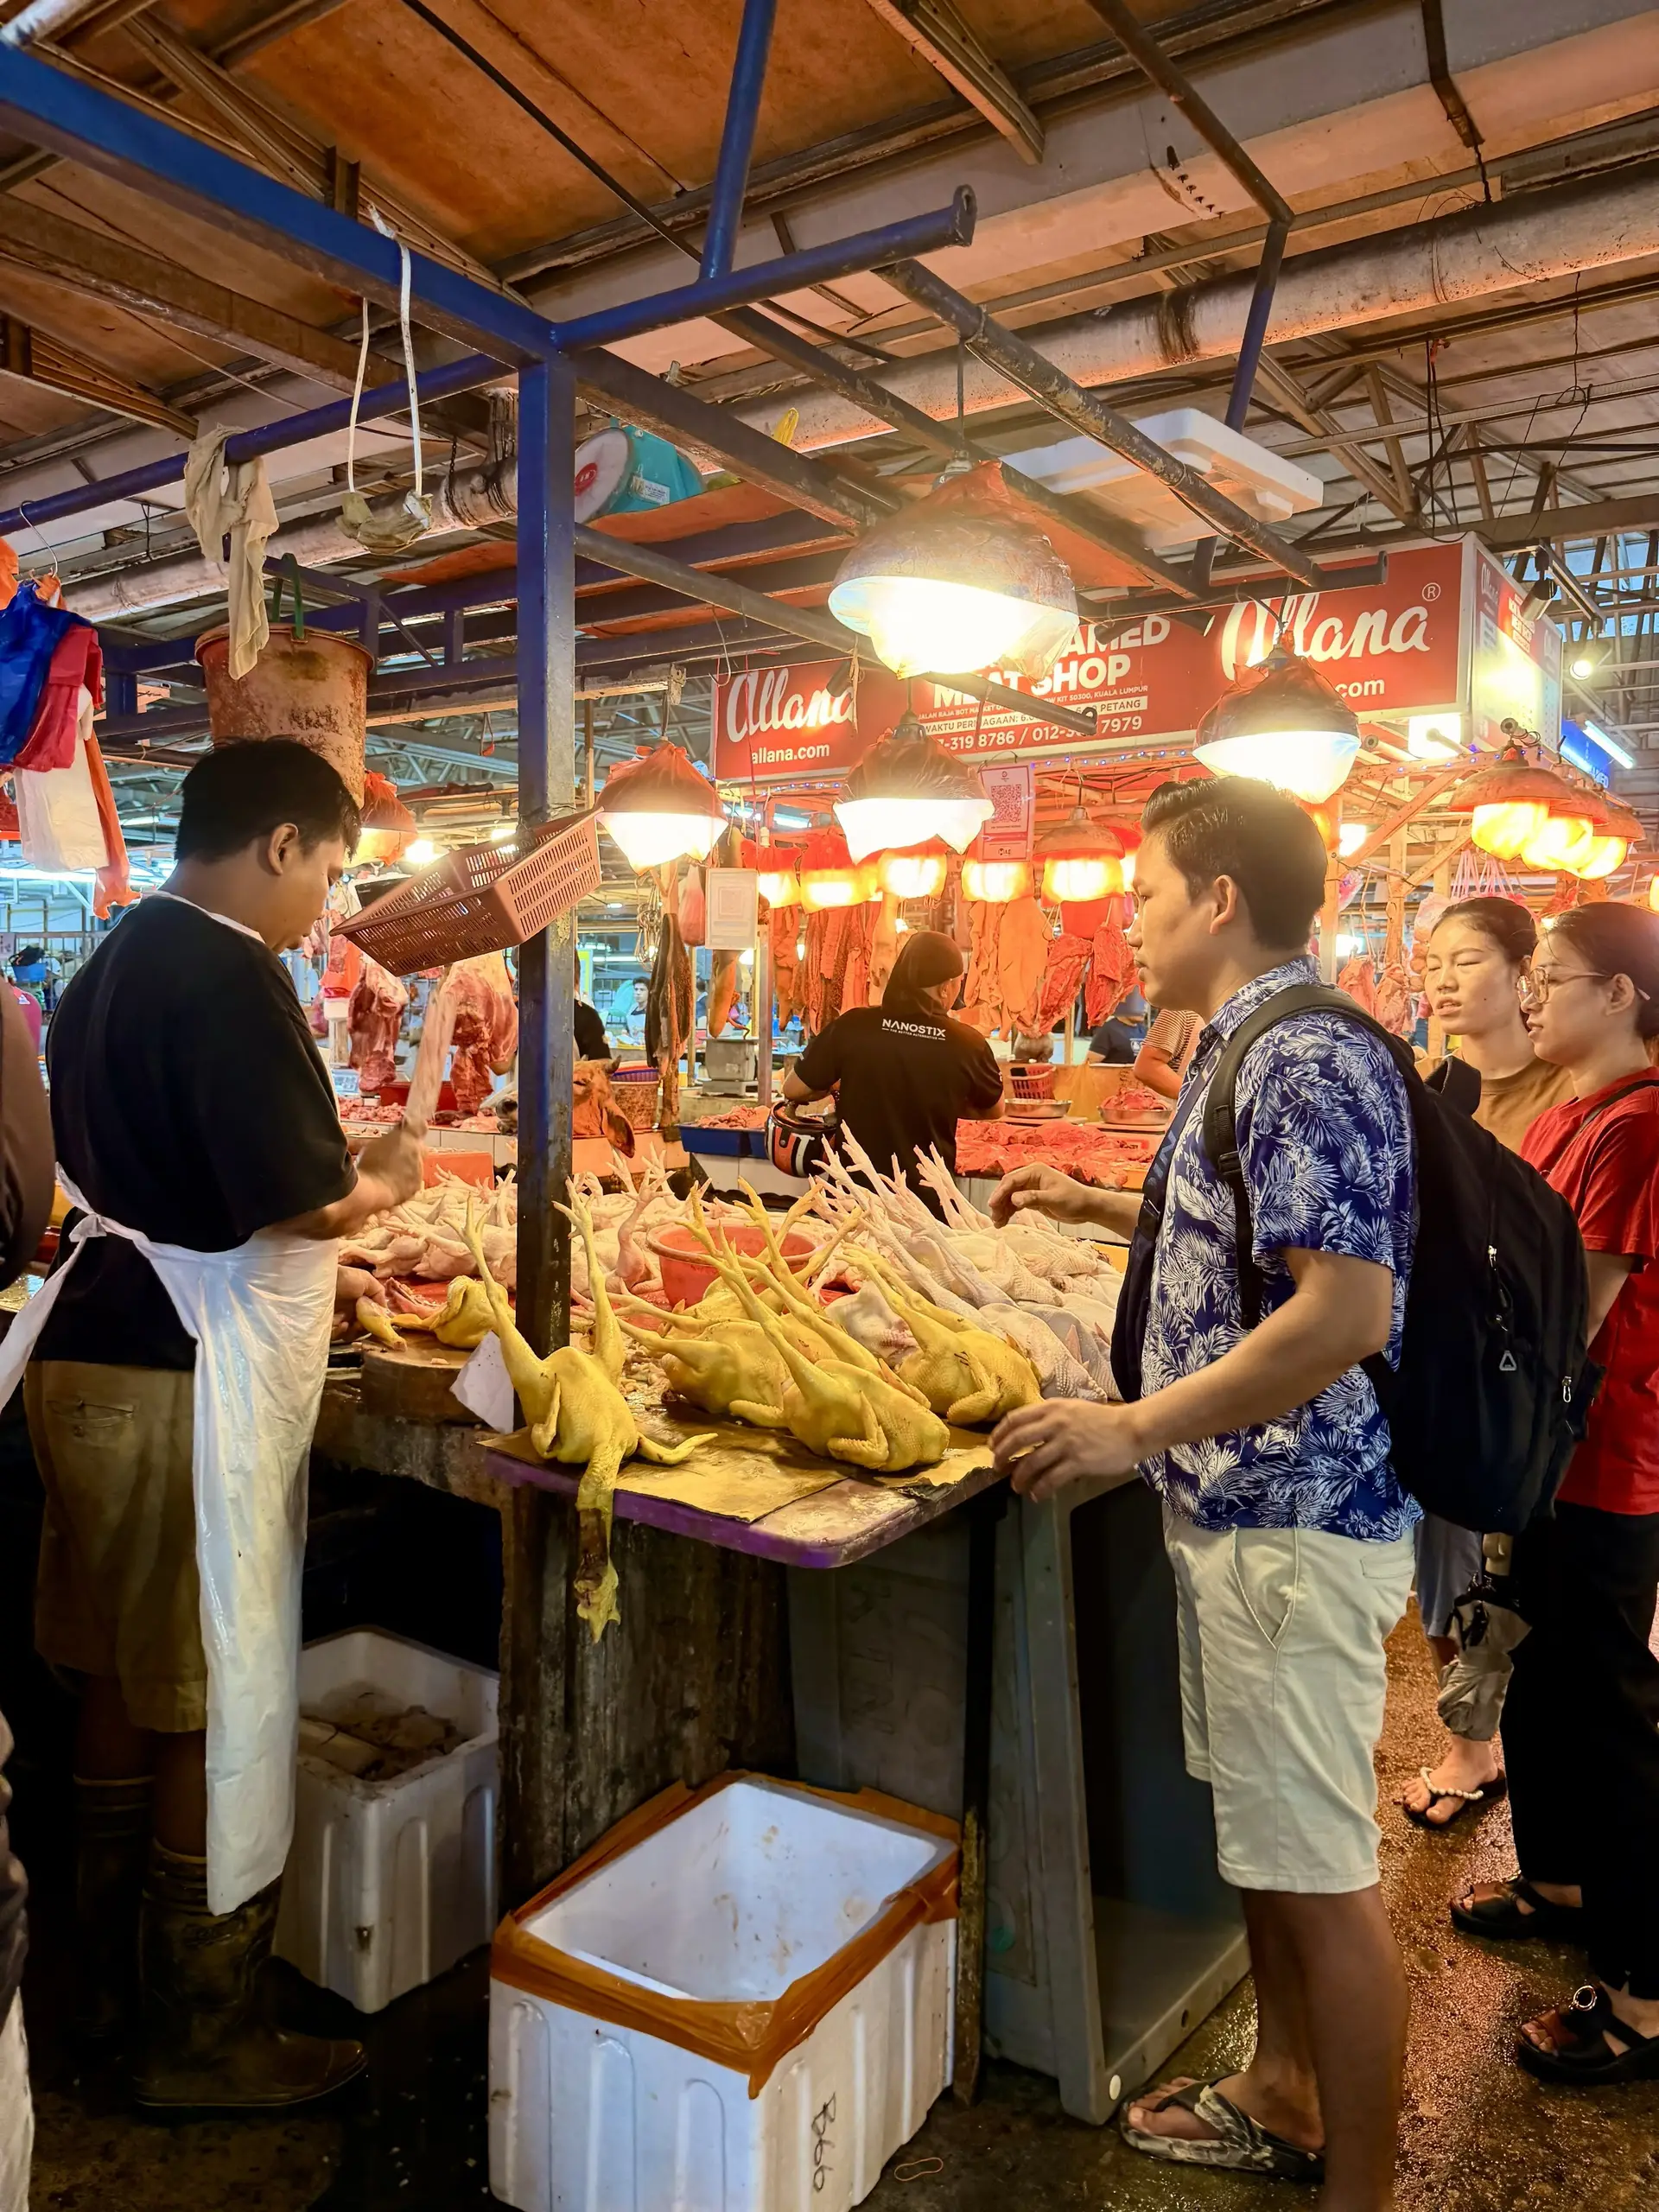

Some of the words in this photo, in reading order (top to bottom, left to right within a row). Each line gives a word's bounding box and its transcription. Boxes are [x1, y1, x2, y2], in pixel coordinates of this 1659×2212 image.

[1058, 615, 1171, 658] AMED
[1031, 654, 1131, 696] SHOP
[957, 715, 1019, 729] PERAGAAN:
[1100, 699, 1141, 712] PETANG
[969, 705, 995, 715] MAKET
[1070, 692, 1092, 701] 50300,
[1094, 689, 1118, 698] KUALA
[1119, 685, 1148, 695] LUMPUR
[978, 730, 1015, 747] 8786
[1019, 727, 1028, 746] /
[1101, 715, 1142, 734] 7979
[752, 743, 830, 764] allana.com
[882, 1018, 946, 1038] NANOSTIX
